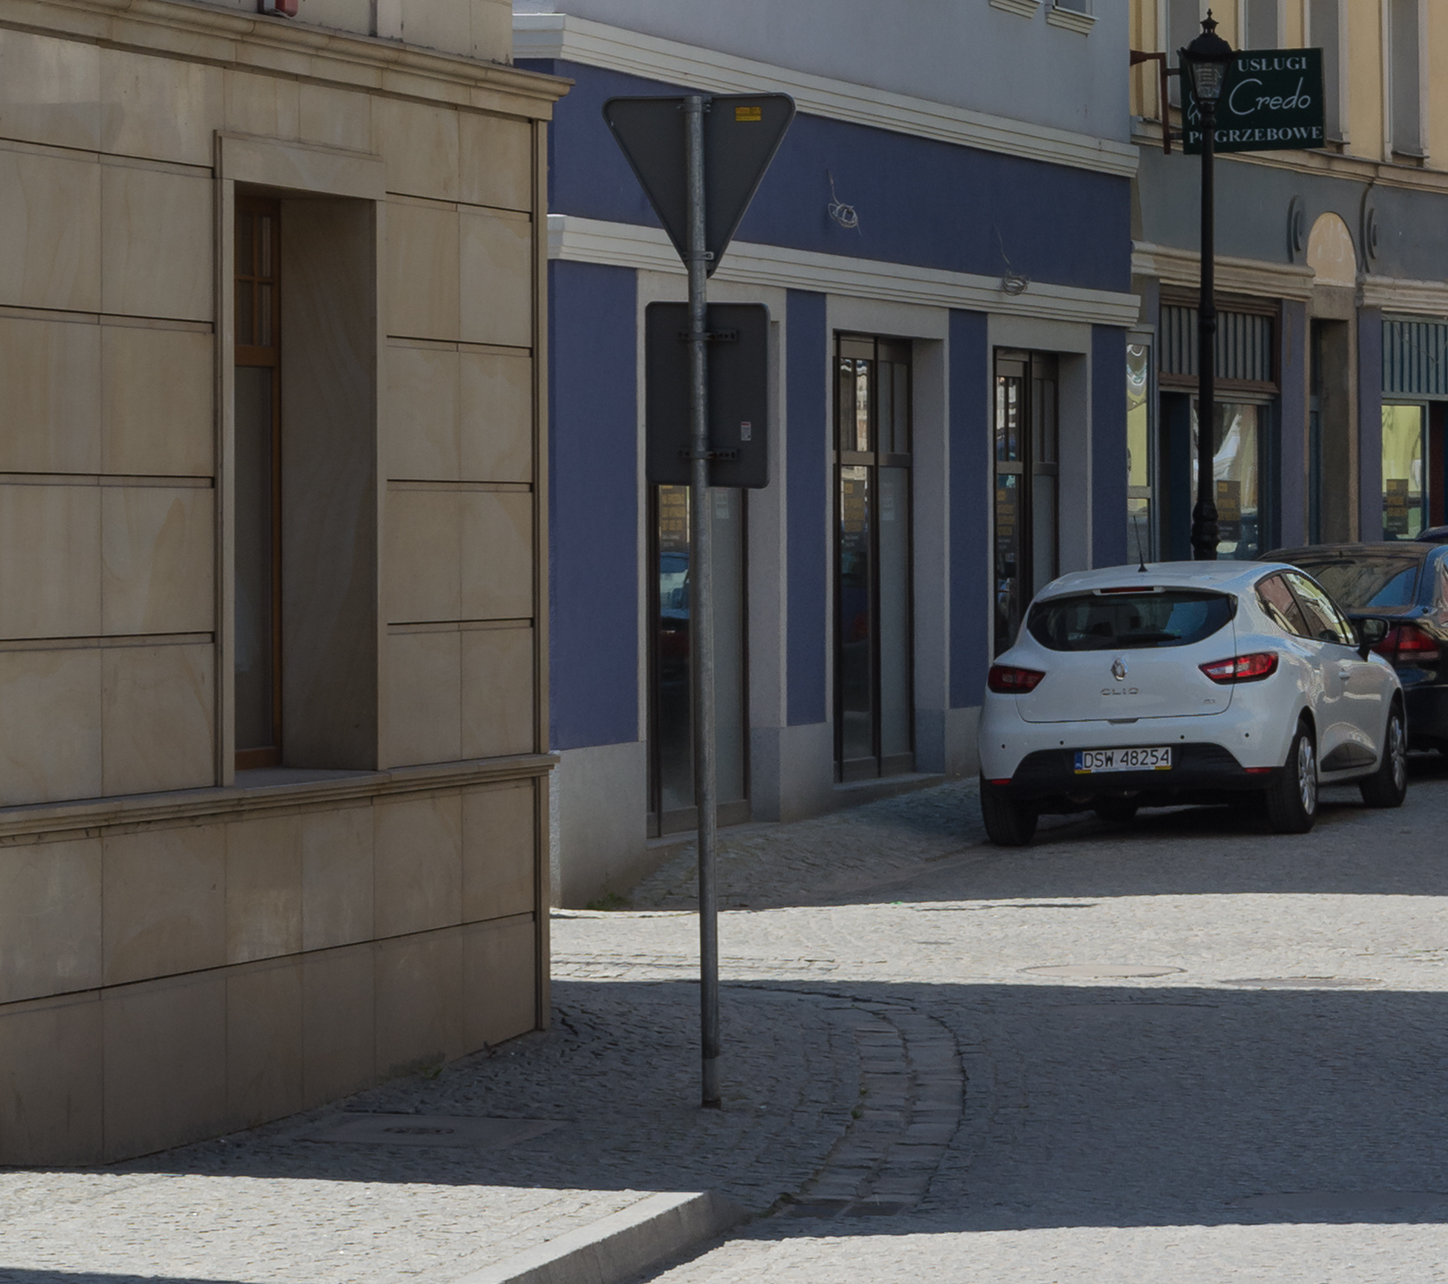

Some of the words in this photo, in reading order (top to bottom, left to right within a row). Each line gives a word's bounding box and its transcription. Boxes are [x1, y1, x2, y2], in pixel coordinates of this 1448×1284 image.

[1229, 76, 1311, 116] Credo
[1189, 126, 1323, 144] PGRZEBOWE
[1100, 687, 1139, 696] CLIO
[1083, 751, 1115, 769] DSW
[1120, 748, 1170, 767] 48254
